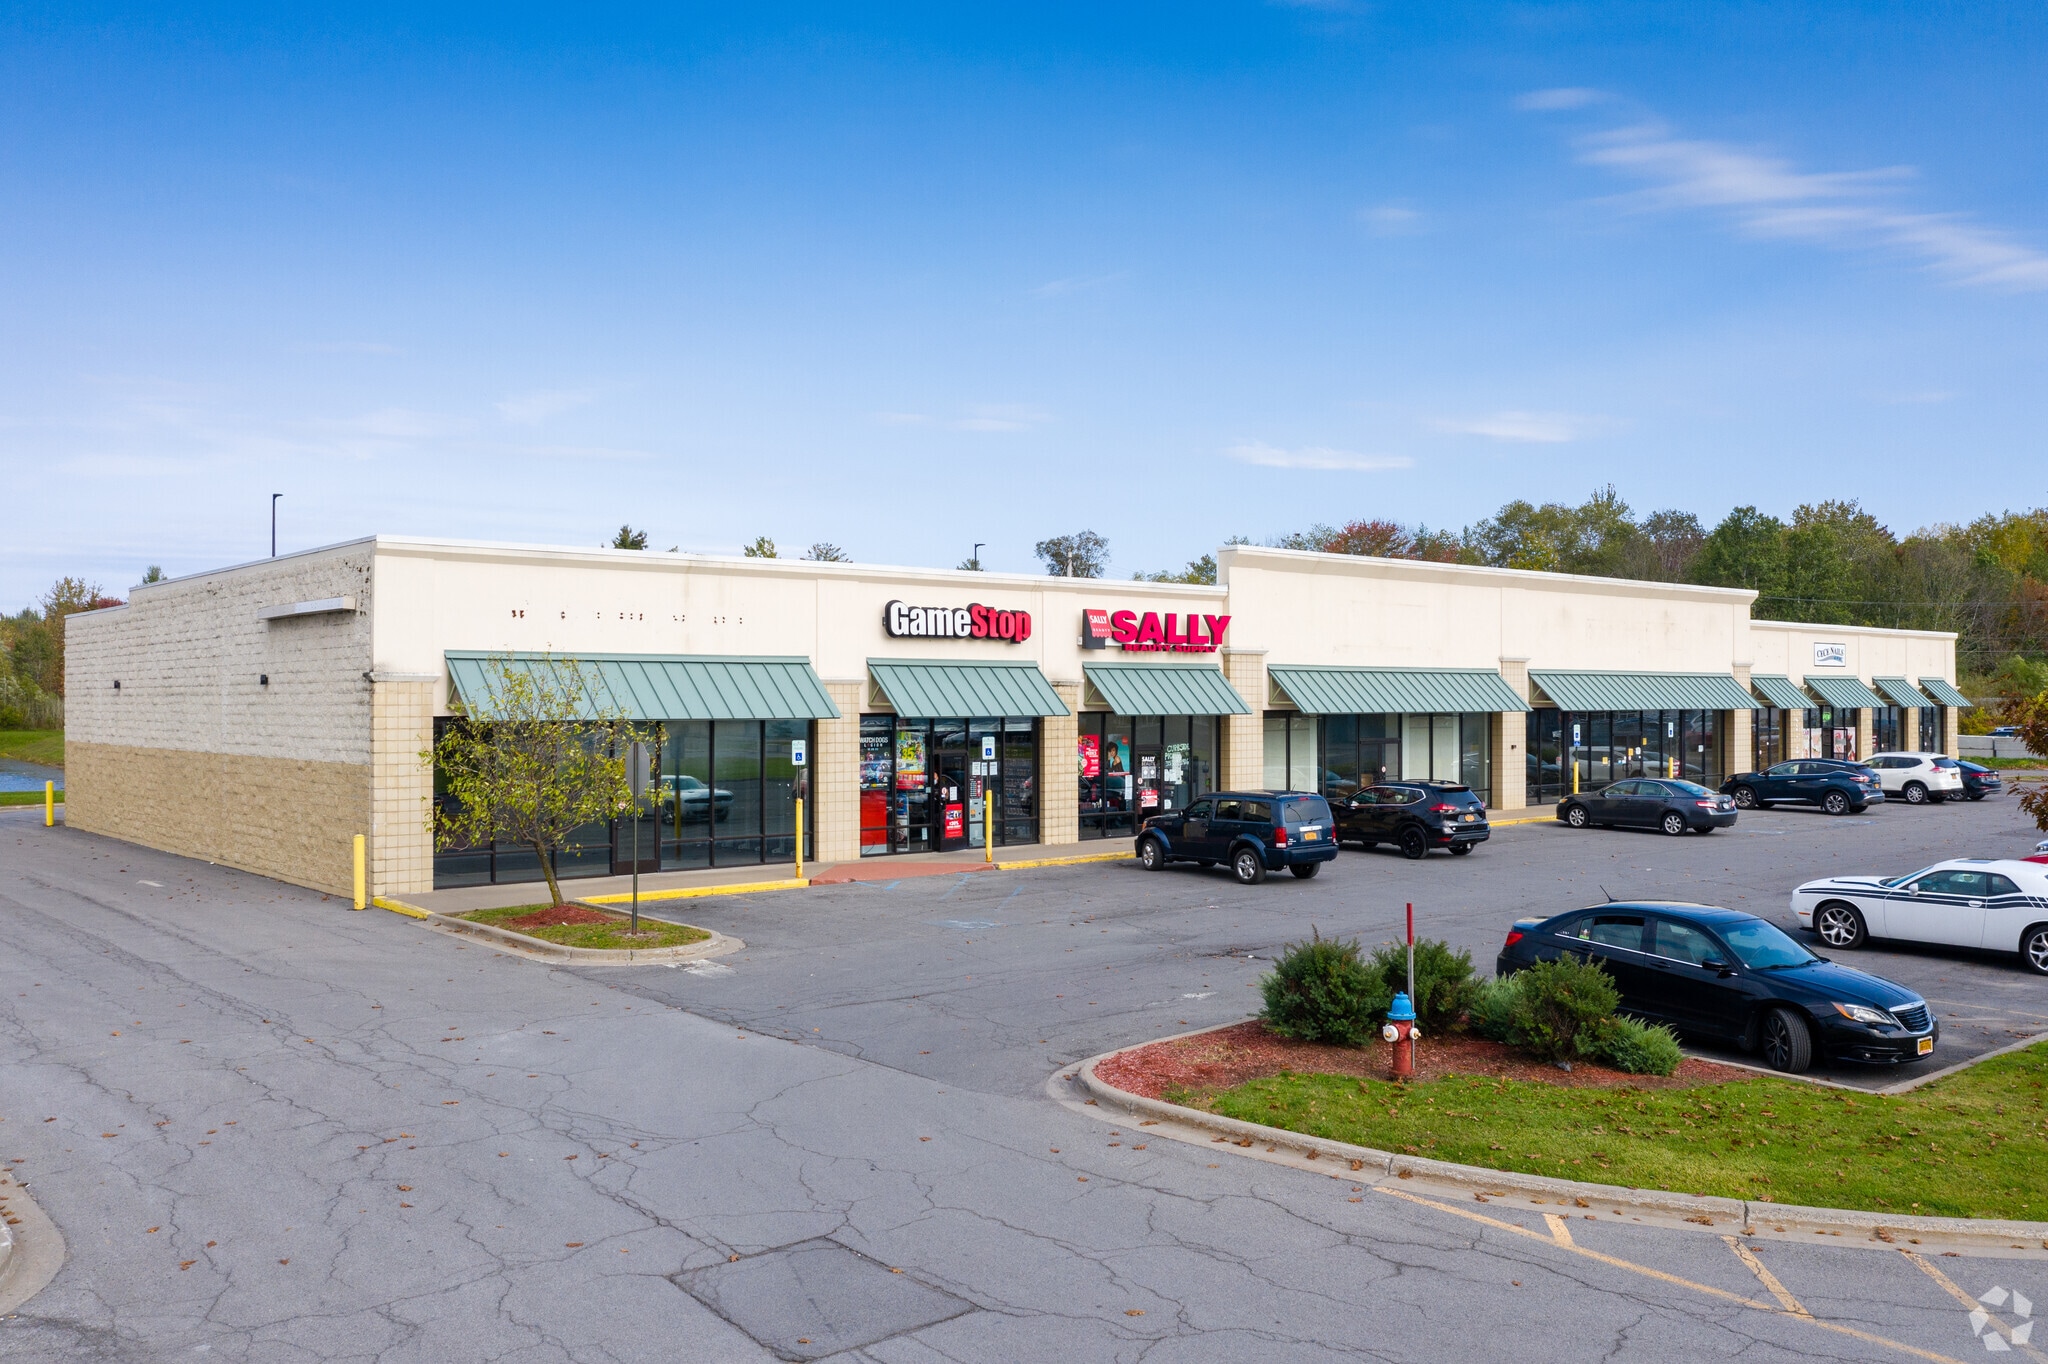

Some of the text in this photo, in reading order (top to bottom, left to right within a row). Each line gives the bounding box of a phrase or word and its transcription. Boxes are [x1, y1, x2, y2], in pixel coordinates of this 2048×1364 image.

[887, 600, 1032, 643] GameStop
[1089, 614, 1108, 625] SALLY
[1111, 609, 1232, 645] SALLY
[1123, 643, 1218, 654] BEAUTY SUPPLY
